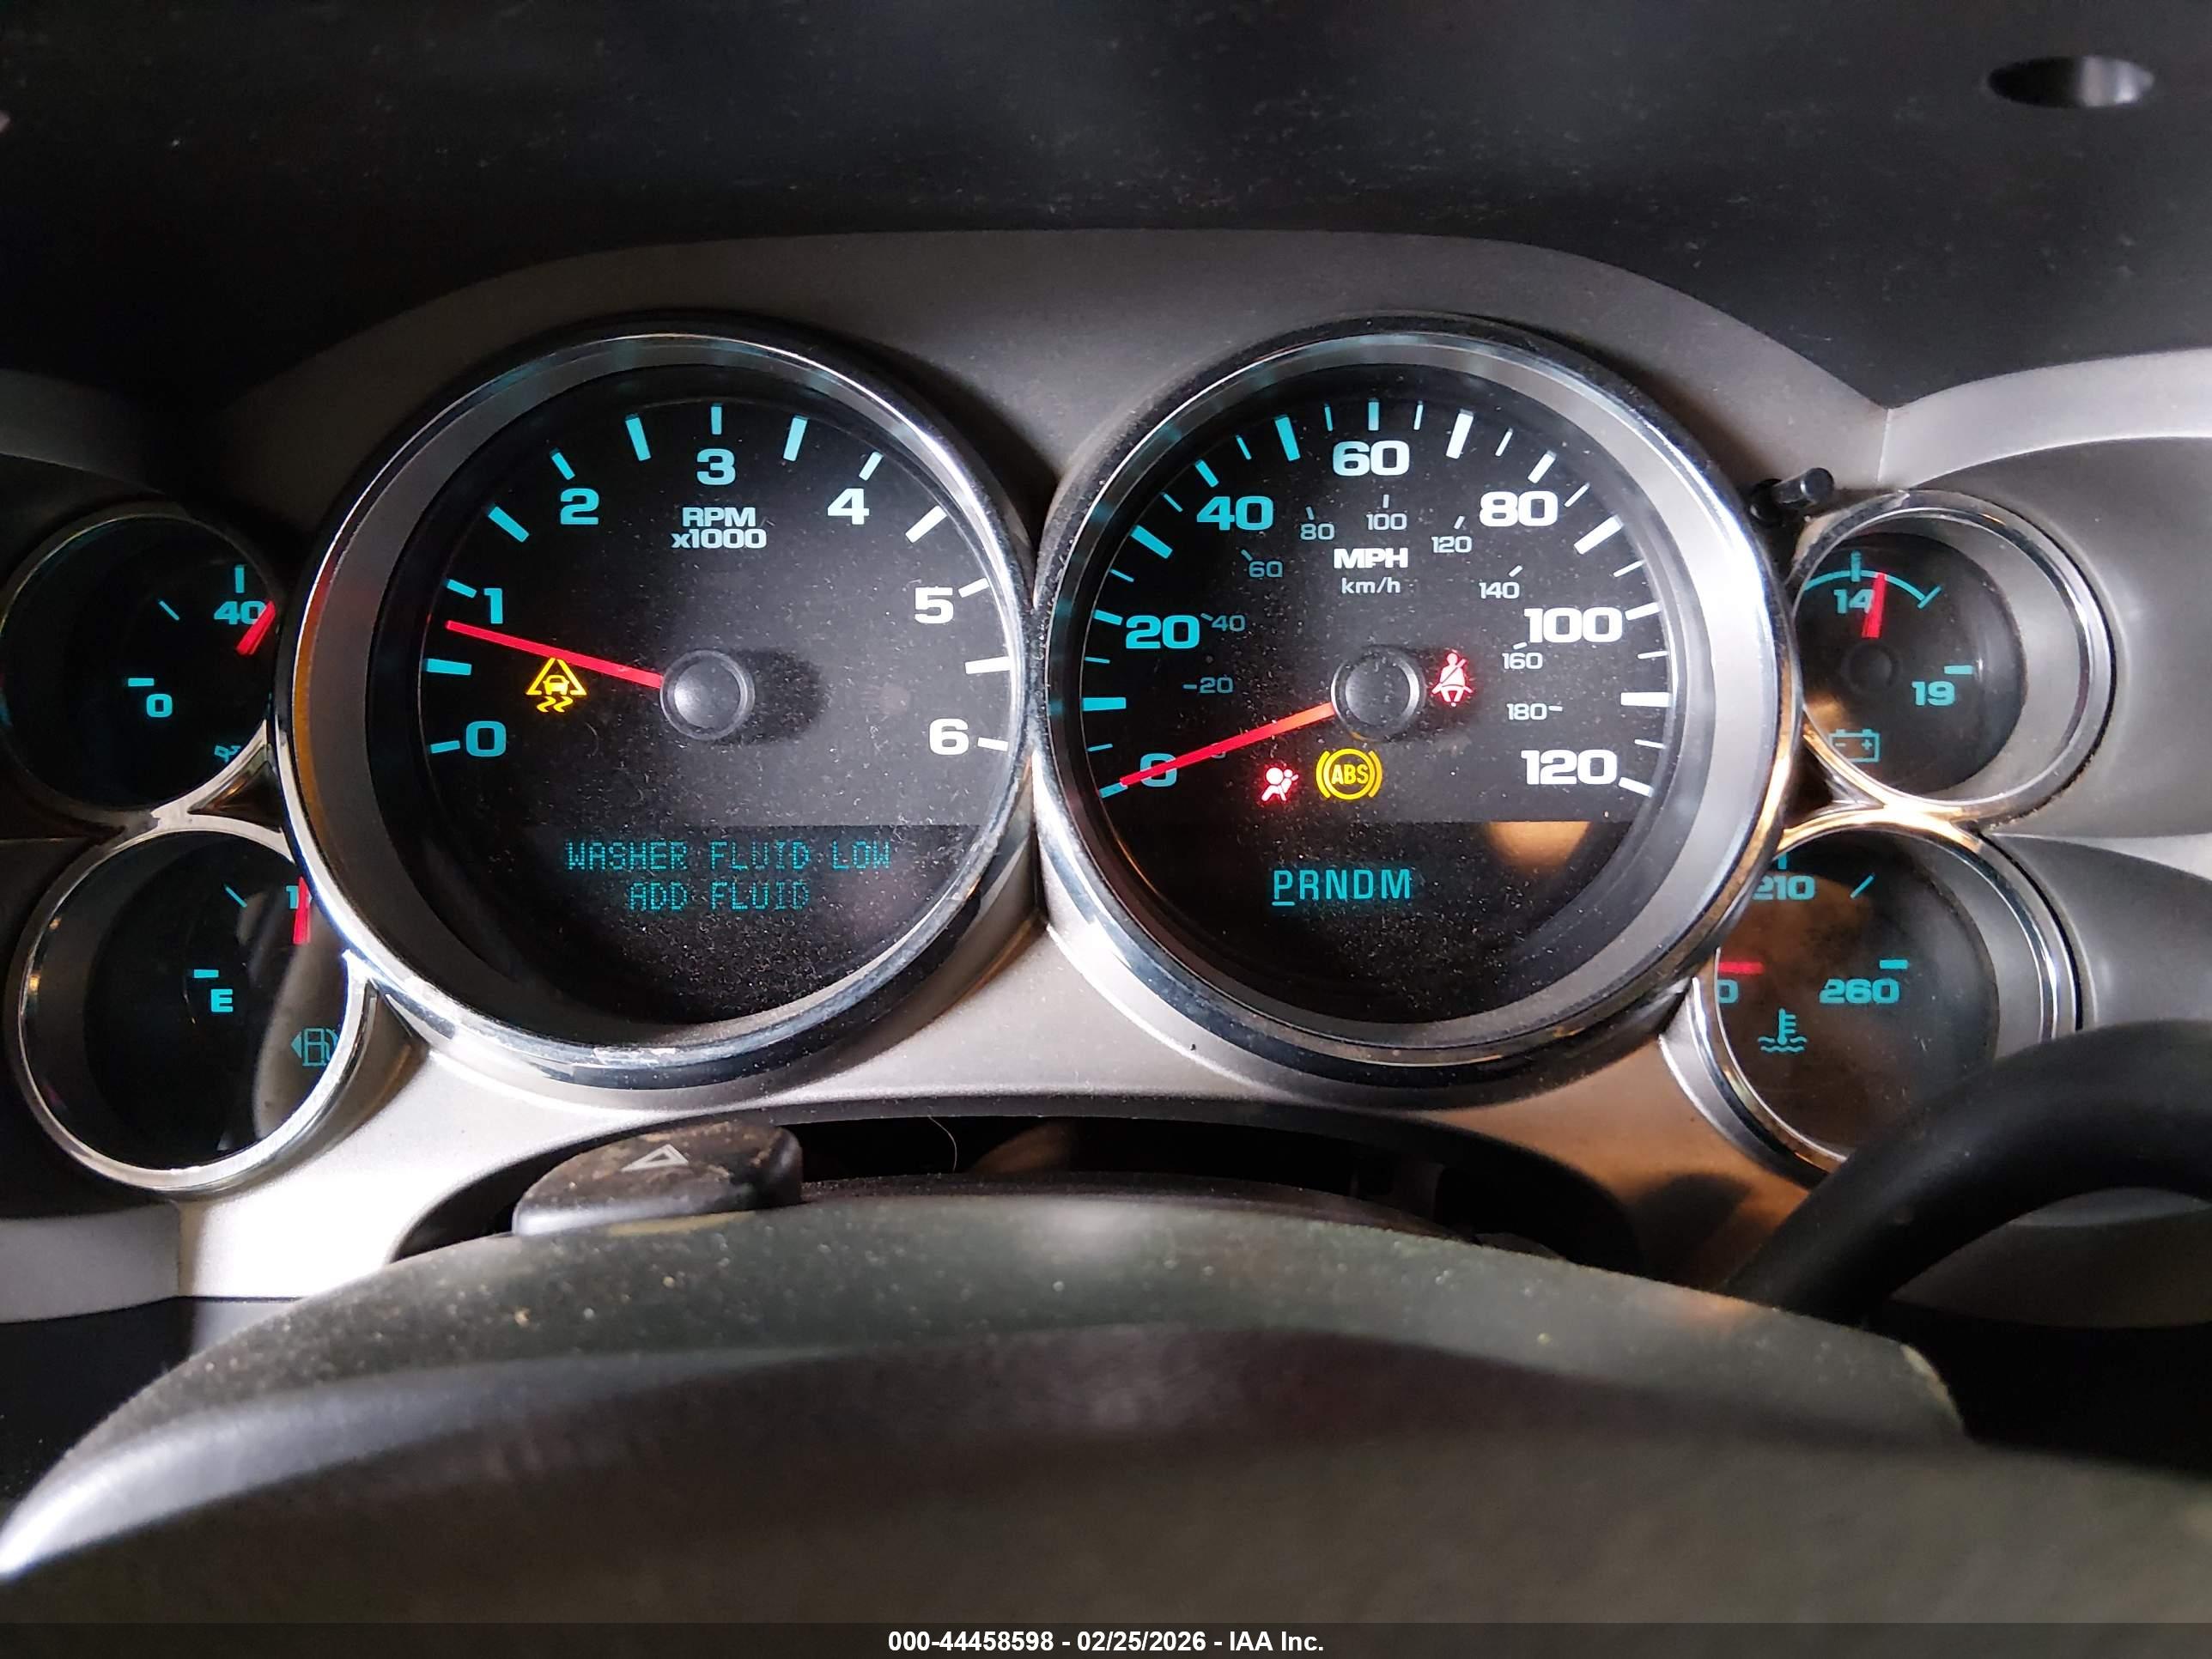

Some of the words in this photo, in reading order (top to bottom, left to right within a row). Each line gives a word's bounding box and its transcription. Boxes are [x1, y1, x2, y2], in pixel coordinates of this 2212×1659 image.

[697, 449, 735, 485] 3
[1334, 441, 1409, 476] 60
[561, 489, 599, 525] 2
[683, 507, 756, 526] RPM
[828, 489, 869, 525] 4
[1197, 496, 1273, 530] 40
[1480, 491, 1558, 526] 80
[1301, 524, 1334, 539] 80
[1366, 514, 1407, 530] 100
[672, 530, 766, 548] x1000
[1431, 536, 1472, 552] 120
[1248, 562, 1282, 577] 60
[1334, 548, 1408, 568] MPH
[1342, 577, 1401, 594] km/h
[1480, 582, 1519, 599] 140
[214, 601, 266, 624] 40
[484, 588, 503, 623] 1
[915, 586, 953, 623] 5
[1834, 589, 1874, 613] 14
[1126, 616, 1200, 648] 20
[1212, 615, 1245, 631] 40
[1524, 608, 1622, 642] 100
[1503, 653, 1542, 669] 160
[1200, 678, 1233, 693] 20
[1912, 681, 1954, 705] 19
[147, 694, 172, 717] 0
[1507, 703, 1547, 720] 180
[466, 721, 506, 757] 0
[930, 719, 969, 755] 6
[1140, 753, 1177, 787] 0
[1332, 764, 1369, 784] ABS
[1522, 750, 1617, 784] 120
[566, 842, 688, 870] WASHER
[711, 842, 811, 870] FLUID
[832, 841, 890, 870] LOW
[629, 882, 687, 910] ADD
[711, 882, 808, 910] FLUID
[1753, 876, 1814, 900] 210
[211, 989, 233, 1012] E
[1820, 979, 1899, 1003] 260
